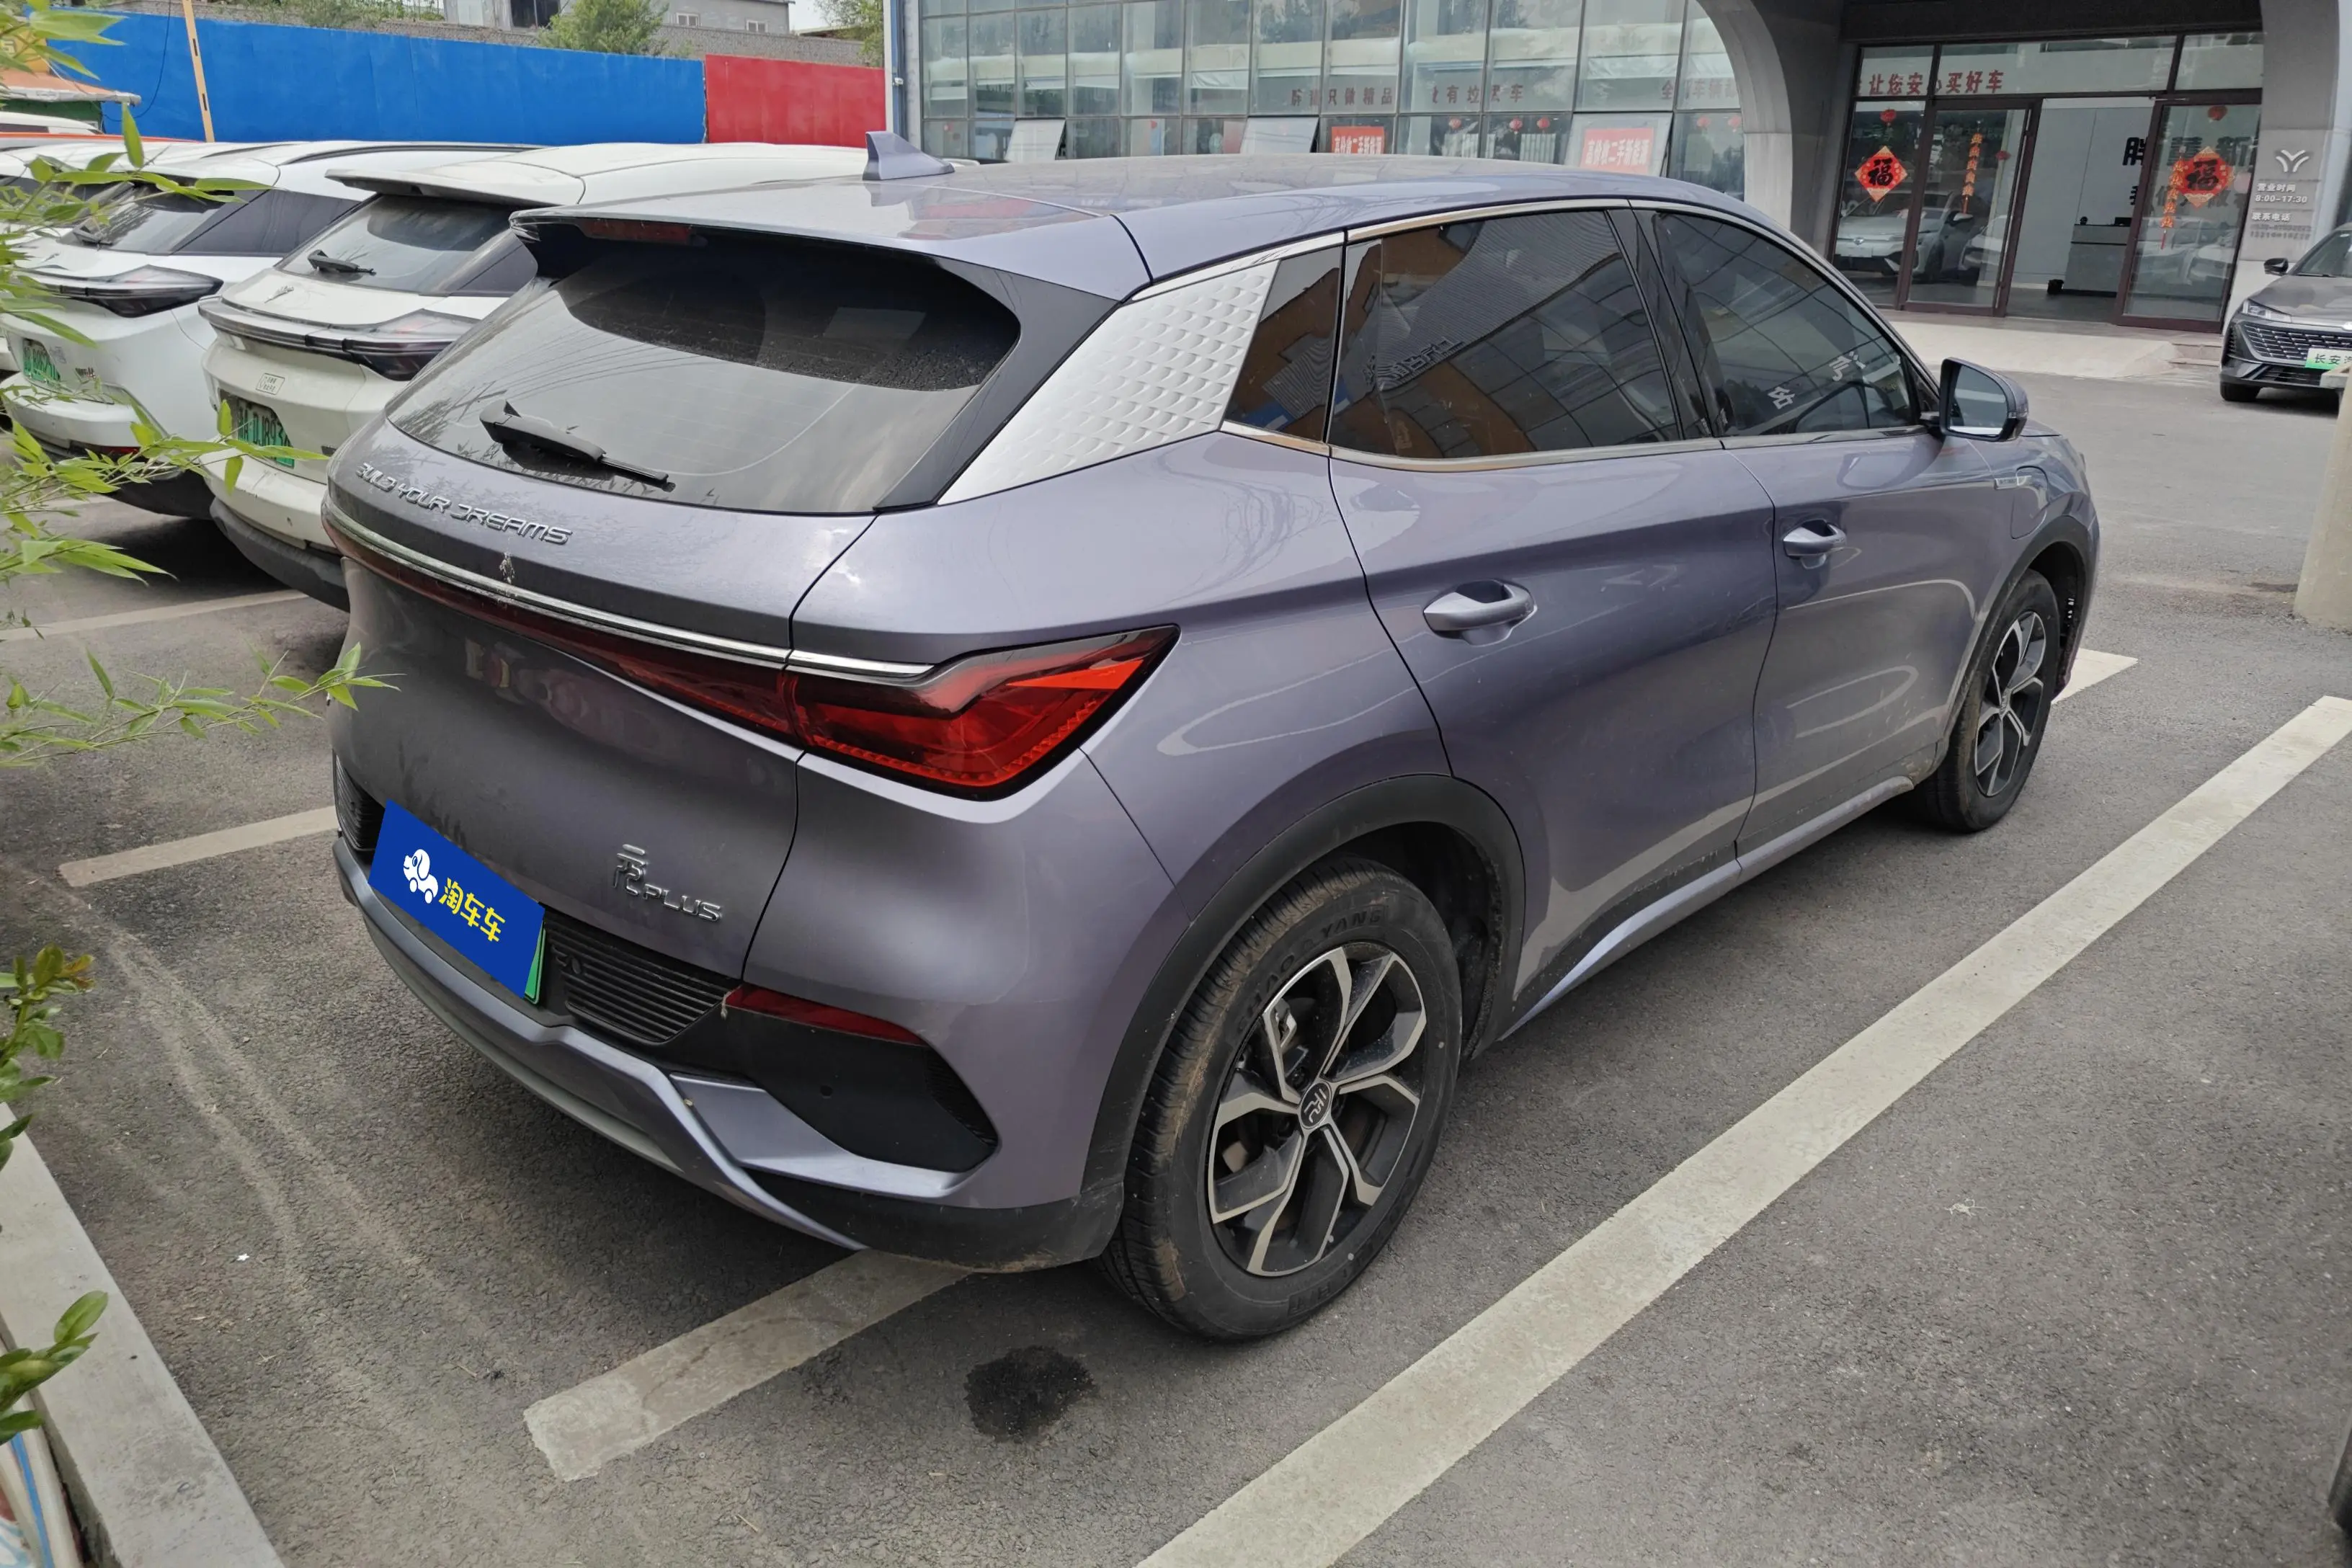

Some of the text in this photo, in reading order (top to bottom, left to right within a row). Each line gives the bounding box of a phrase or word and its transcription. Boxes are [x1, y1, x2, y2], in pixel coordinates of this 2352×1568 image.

[1867, 157, 1894, 187] 福
[2186, 158, 2220, 191] 福
[2255, 195, 2308, 203] 8:00-17:30
[2256, 183, 2297, 192] 营业时间
[2251, 213, 2291, 222] 联系电话
[398, 483, 453, 514] YOUR
[450, 503, 574, 545] DREAMS
[643, 883, 723, 922] PLUS
